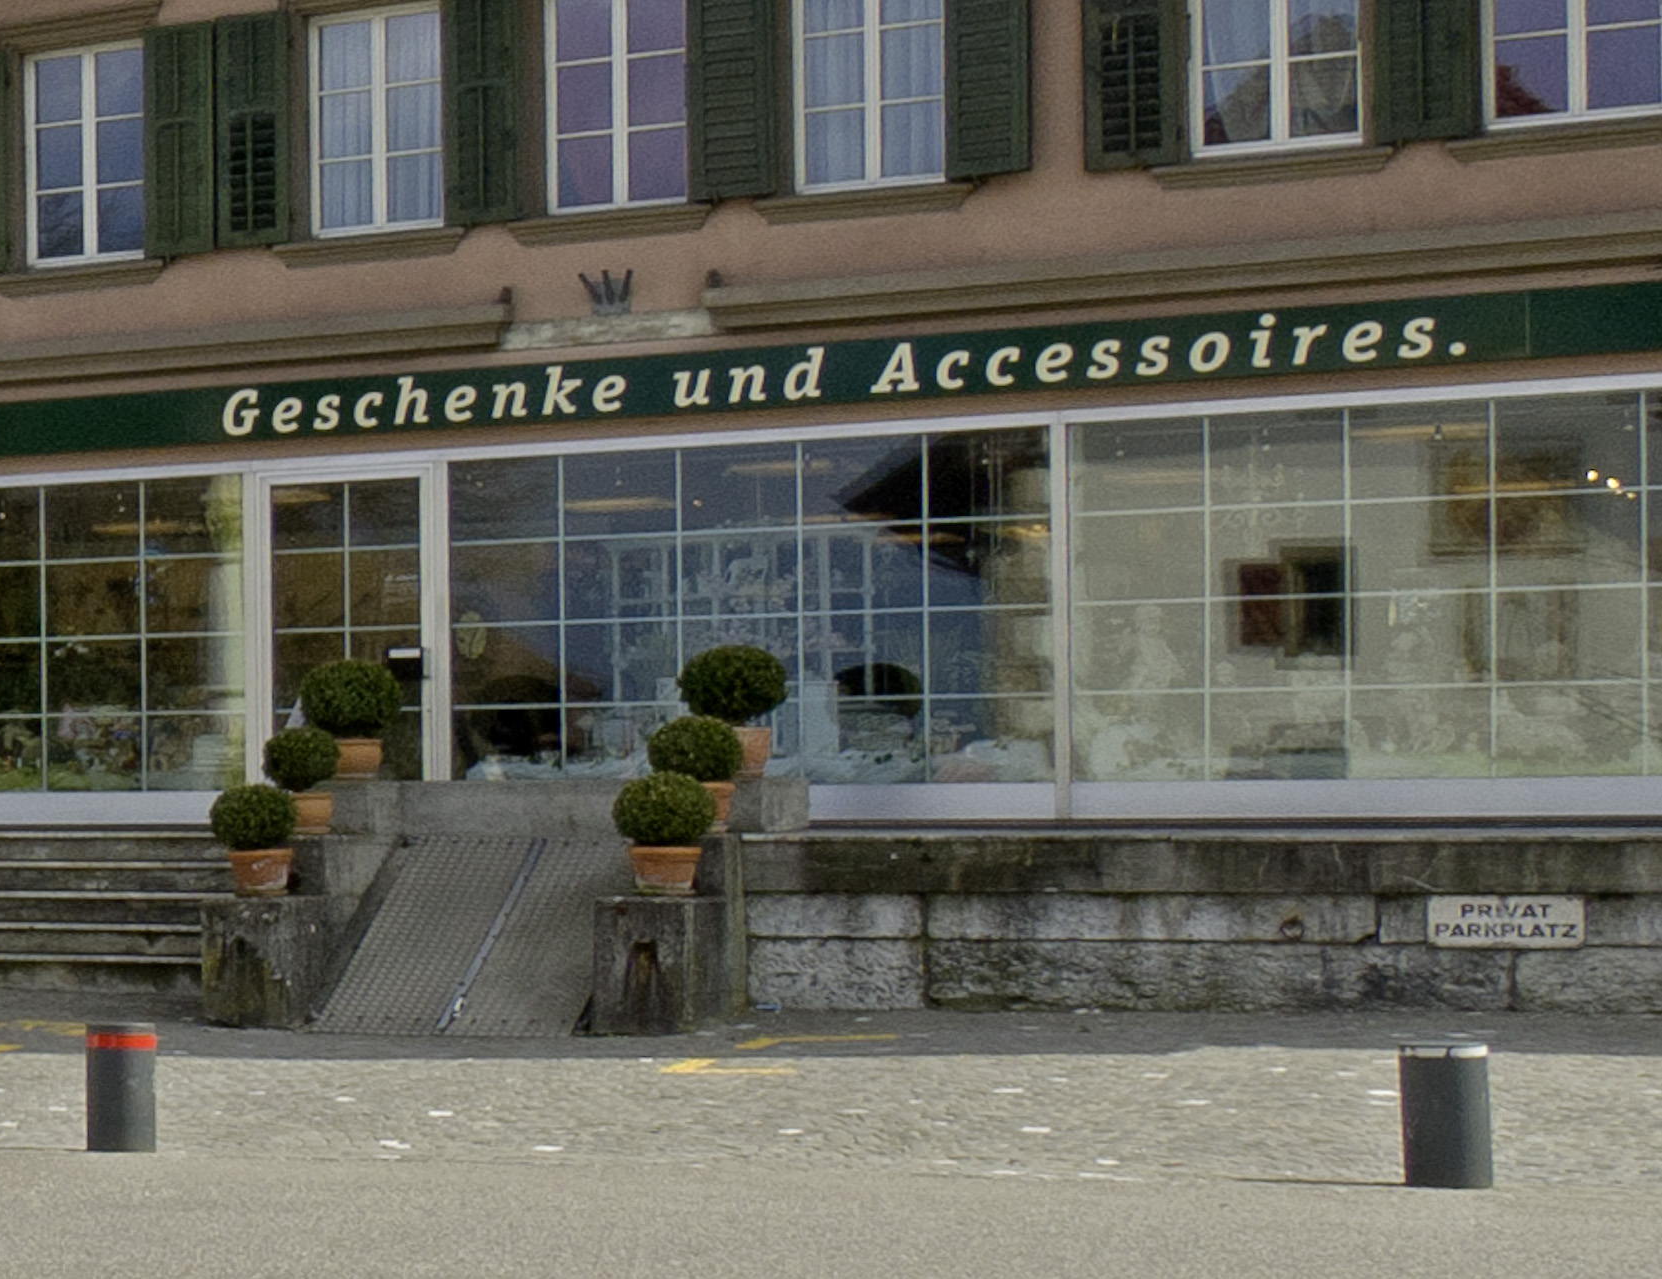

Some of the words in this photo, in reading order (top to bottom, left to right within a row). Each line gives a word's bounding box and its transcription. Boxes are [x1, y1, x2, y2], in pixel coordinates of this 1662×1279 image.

[222, 361, 628, 436] Geschenke
[673, 348, 825, 408] und
[870, 312, 1468, 395] Accessoires.
[1460, 903, 1552, 918] PRIVAT
[1434, 922, 1579, 938] PARKPLATZ
